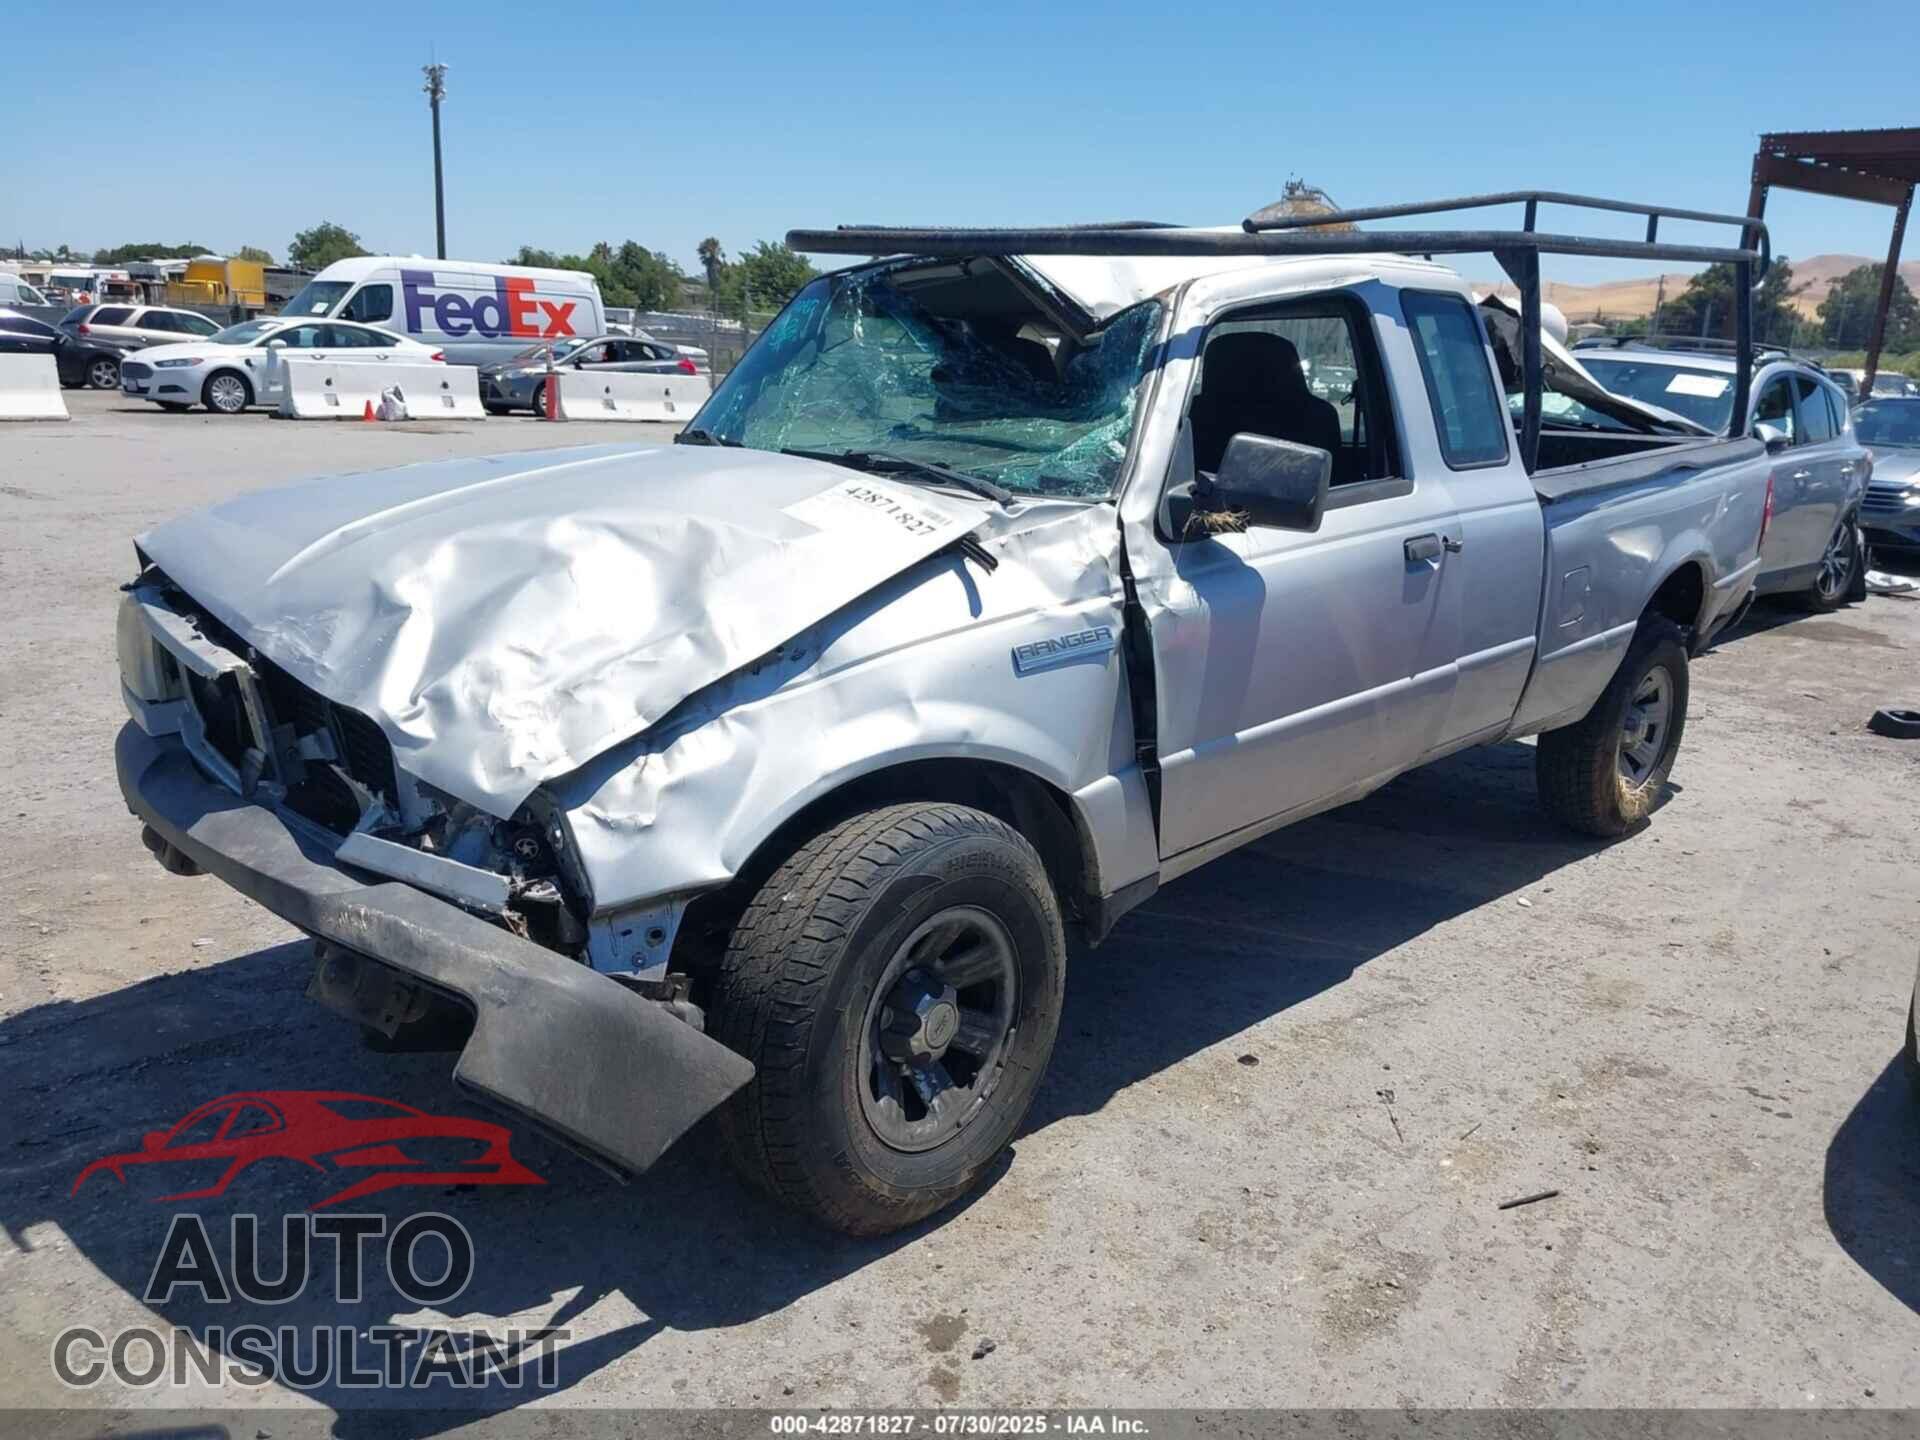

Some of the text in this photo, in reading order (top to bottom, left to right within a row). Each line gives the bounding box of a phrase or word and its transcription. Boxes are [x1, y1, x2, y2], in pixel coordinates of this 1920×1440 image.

[401, 269, 577, 338] FedEx
[845, 486, 937, 536] 42871827
[1016, 627, 1113, 659] RANGER
